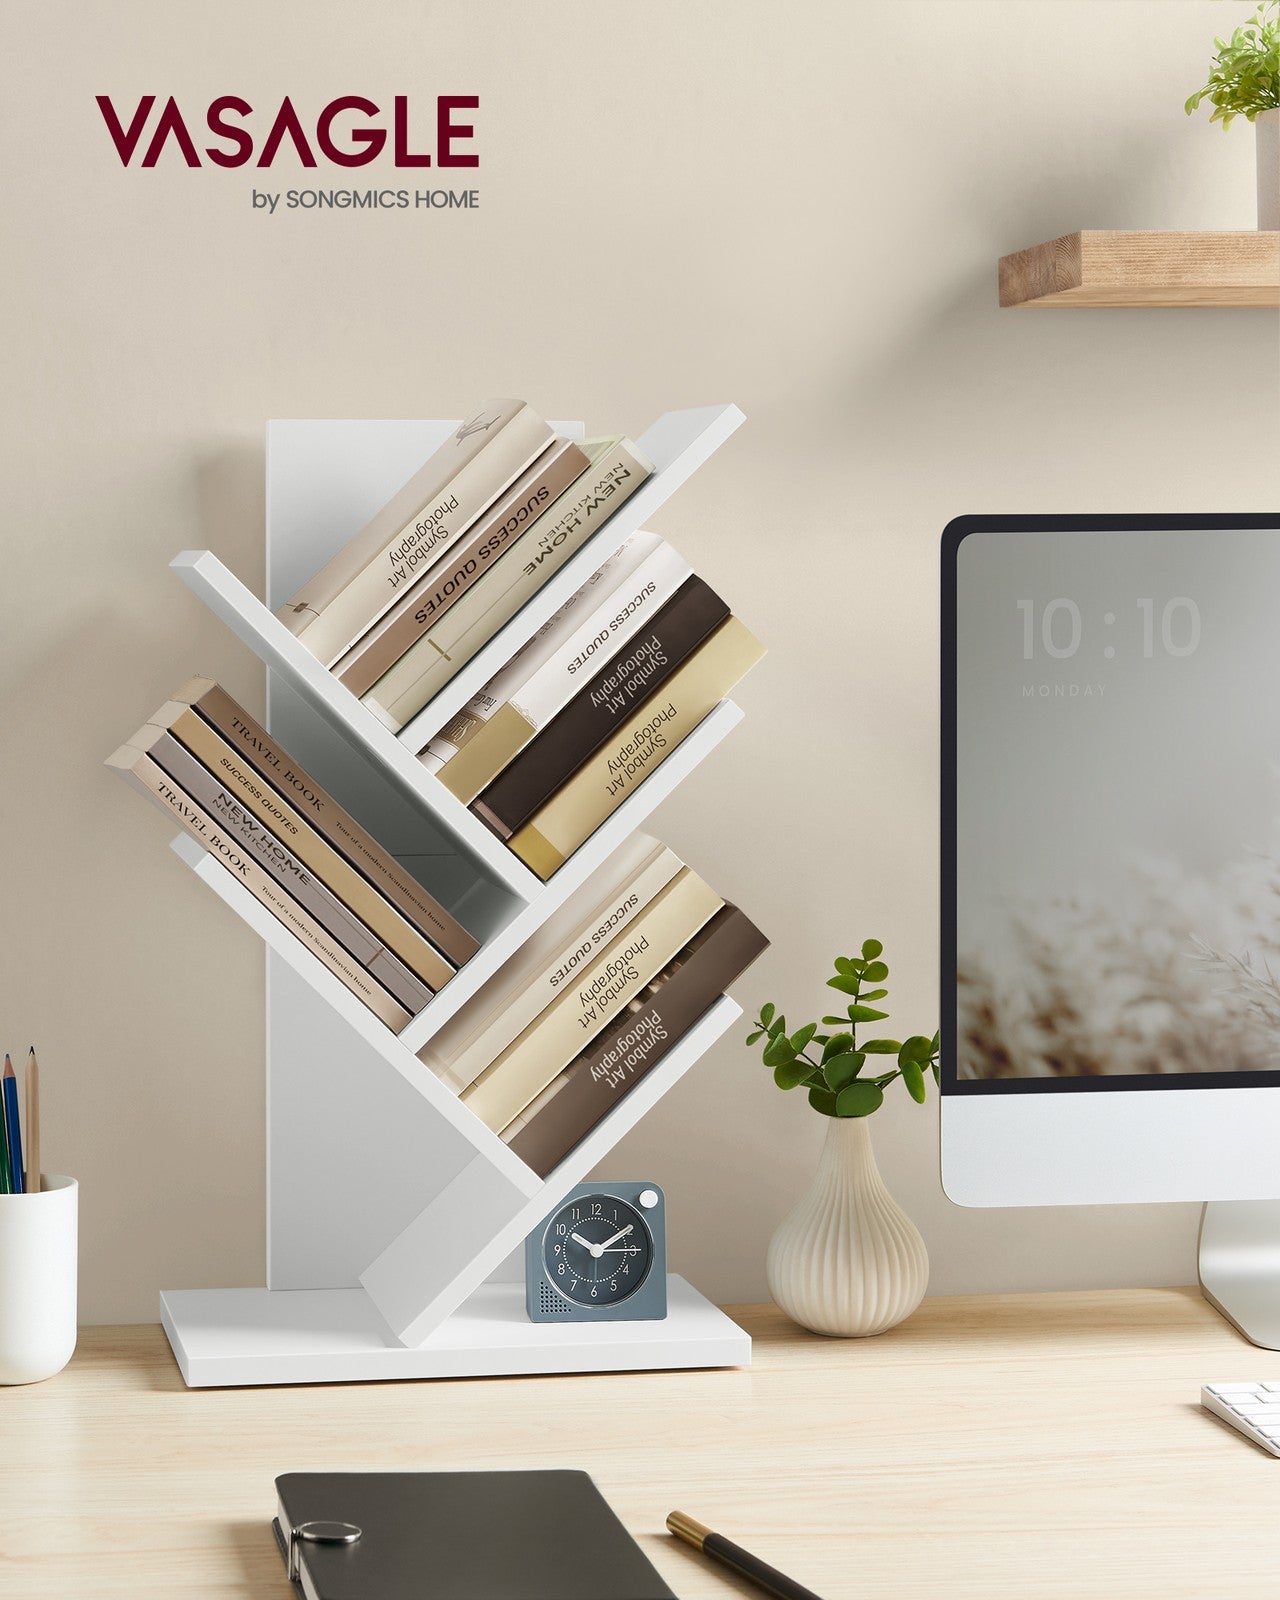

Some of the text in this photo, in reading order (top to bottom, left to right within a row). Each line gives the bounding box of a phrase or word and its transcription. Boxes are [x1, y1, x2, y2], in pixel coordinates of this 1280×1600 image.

[586, 469, 631, 517] NEW
[594, 462, 624, 494] NEW
[389, 494, 459, 567] Photography
[522, 517, 582, 576] HOME
[538, 494, 592, 548] KITCHEN
[388, 525, 449, 588] Symbol Art
[414, 486, 550, 624] SUCCESS QUOTES
[608, 581, 656, 632] SUCCESS
[567, 629, 609, 675] QUOTES
[590, 635, 662, 708] Photography
[605, 651, 668, 714] Symbol Art
[1021, 683, 1107, 698] MONDAY
[232, 717, 325, 812] TRAVEL BOOK
[605, 733, 667, 796] Symbol Art
[607, 703, 677, 775] Photography
[220, 758, 298, 835] SUCCESS QUOTES
[157, 781, 251, 877] TRAVEL BOOK
[212, 798, 287, 873] NEW KITCHEN
[217, 792, 311, 886] NEW HOME
[336, 821, 351, 837] Tour
[362, 849, 388, 874] modern
[427, 911, 446, 930] home
[262, 885, 277, 901] Tour
[288, 912, 314, 938] modern
[313, 937, 354, 978] Scandinavian
[353, 976, 372, 995] home
[549, 894, 639, 987] SUCCESS QUOTES
[579, 935, 650, 1008] Photography
[577, 965, 639, 1029] Symbol Art
[590, 1009, 662, 1082] Photography
[605, 1025, 668, 1088] Symbol Art
[555, 1223, 567, 1236] 10
[571, 1208, 580, 1220] 11
[590, 1203, 602, 1216] 12
[613, 1209, 618, 1221] 1
[554, 1244, 561, 1257] 9
[557, 1263, 565, 1276] 8
[622, 1263, 630, 1276] 4
[629, 1244, 637, 1257] 3
[570, 1279, 578, 1292] 7
[590, 1285, 598, 1298] 6
[610, 1279, 618, 1292] 5
